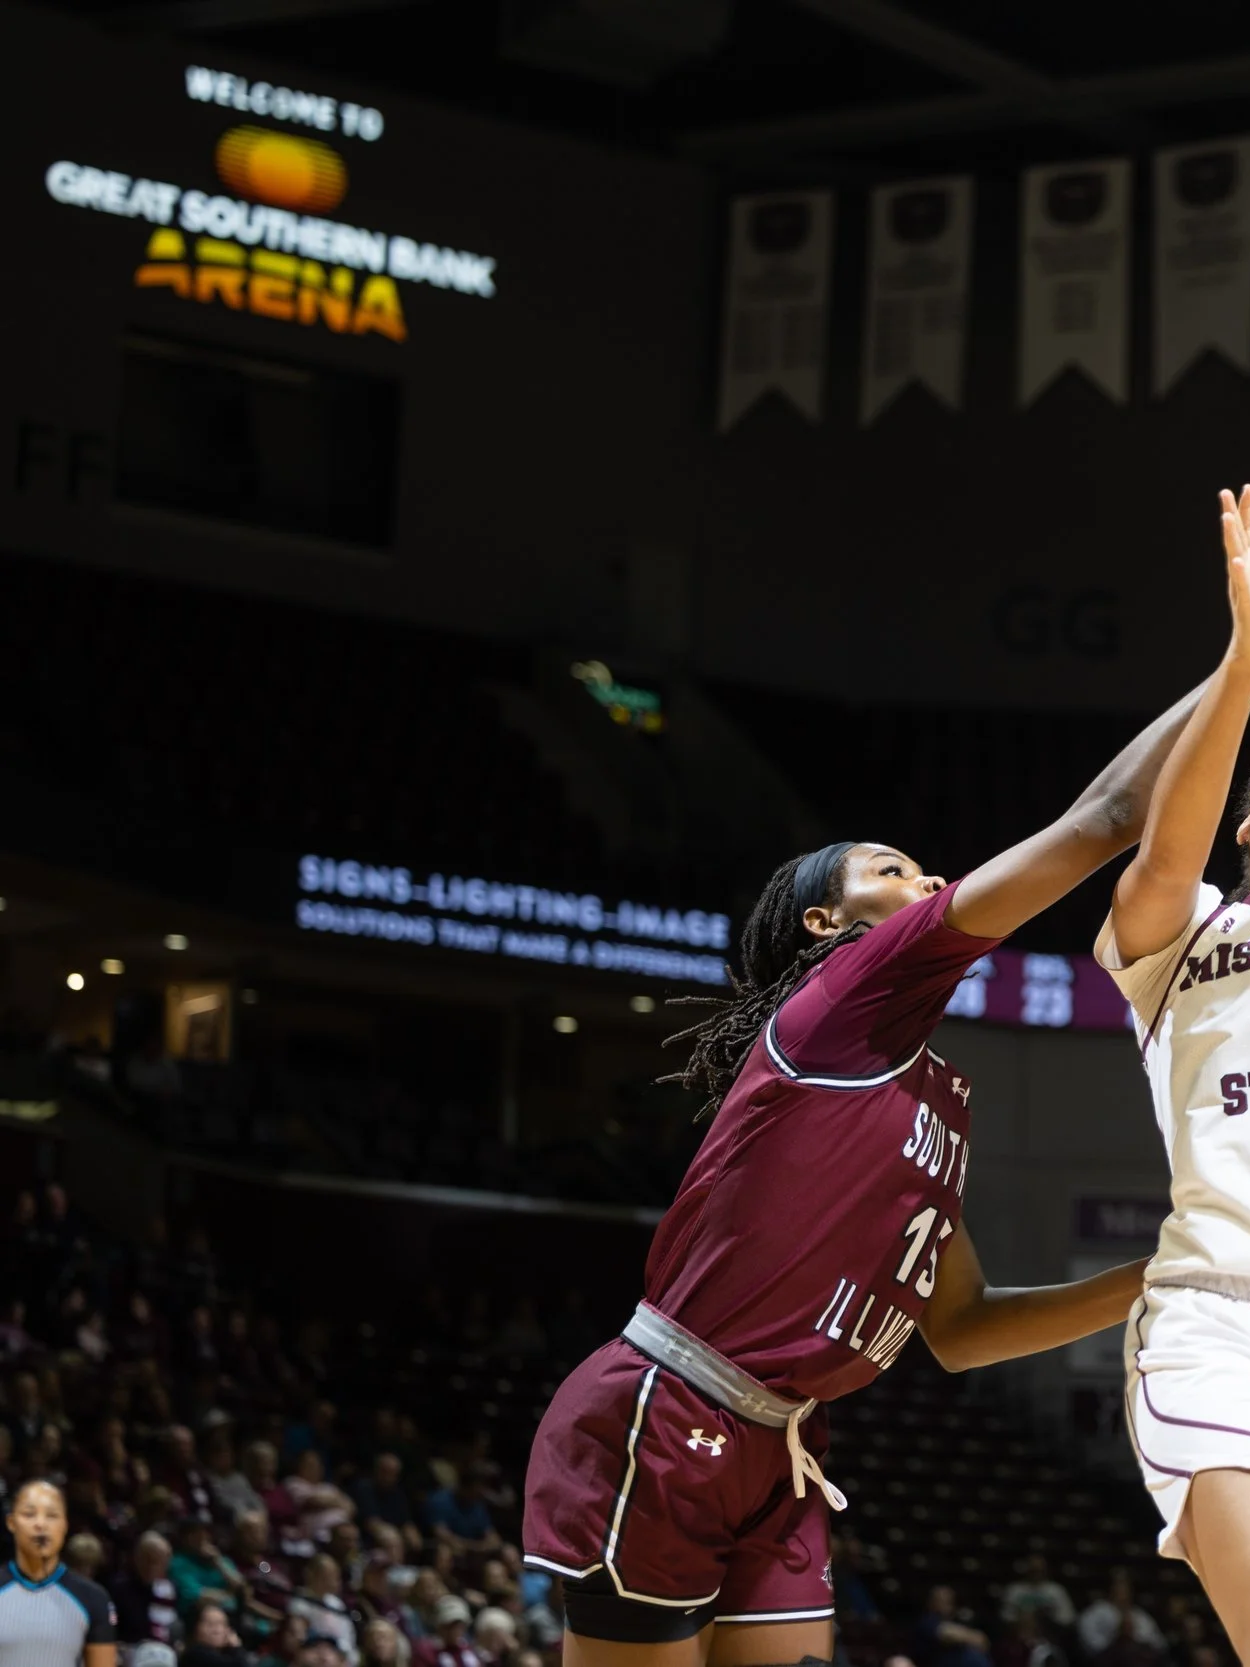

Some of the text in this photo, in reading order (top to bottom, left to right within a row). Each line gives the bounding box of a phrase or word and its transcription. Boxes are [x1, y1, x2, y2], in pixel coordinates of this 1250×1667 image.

[186, 65, 385, 141] WELCOME TO
[45, 160, 497, 298] GREAT SOUTHERN BANK
[134, 227, 408, 342] ARENA
[297, 900, 434, 945] SOLUTIONS
[437, 918, 499, 953] THAT
[502, 930, 568, 962] MAKE
[571, 939, 590, 964] A
[895, 1206, 954, 1299] 15
